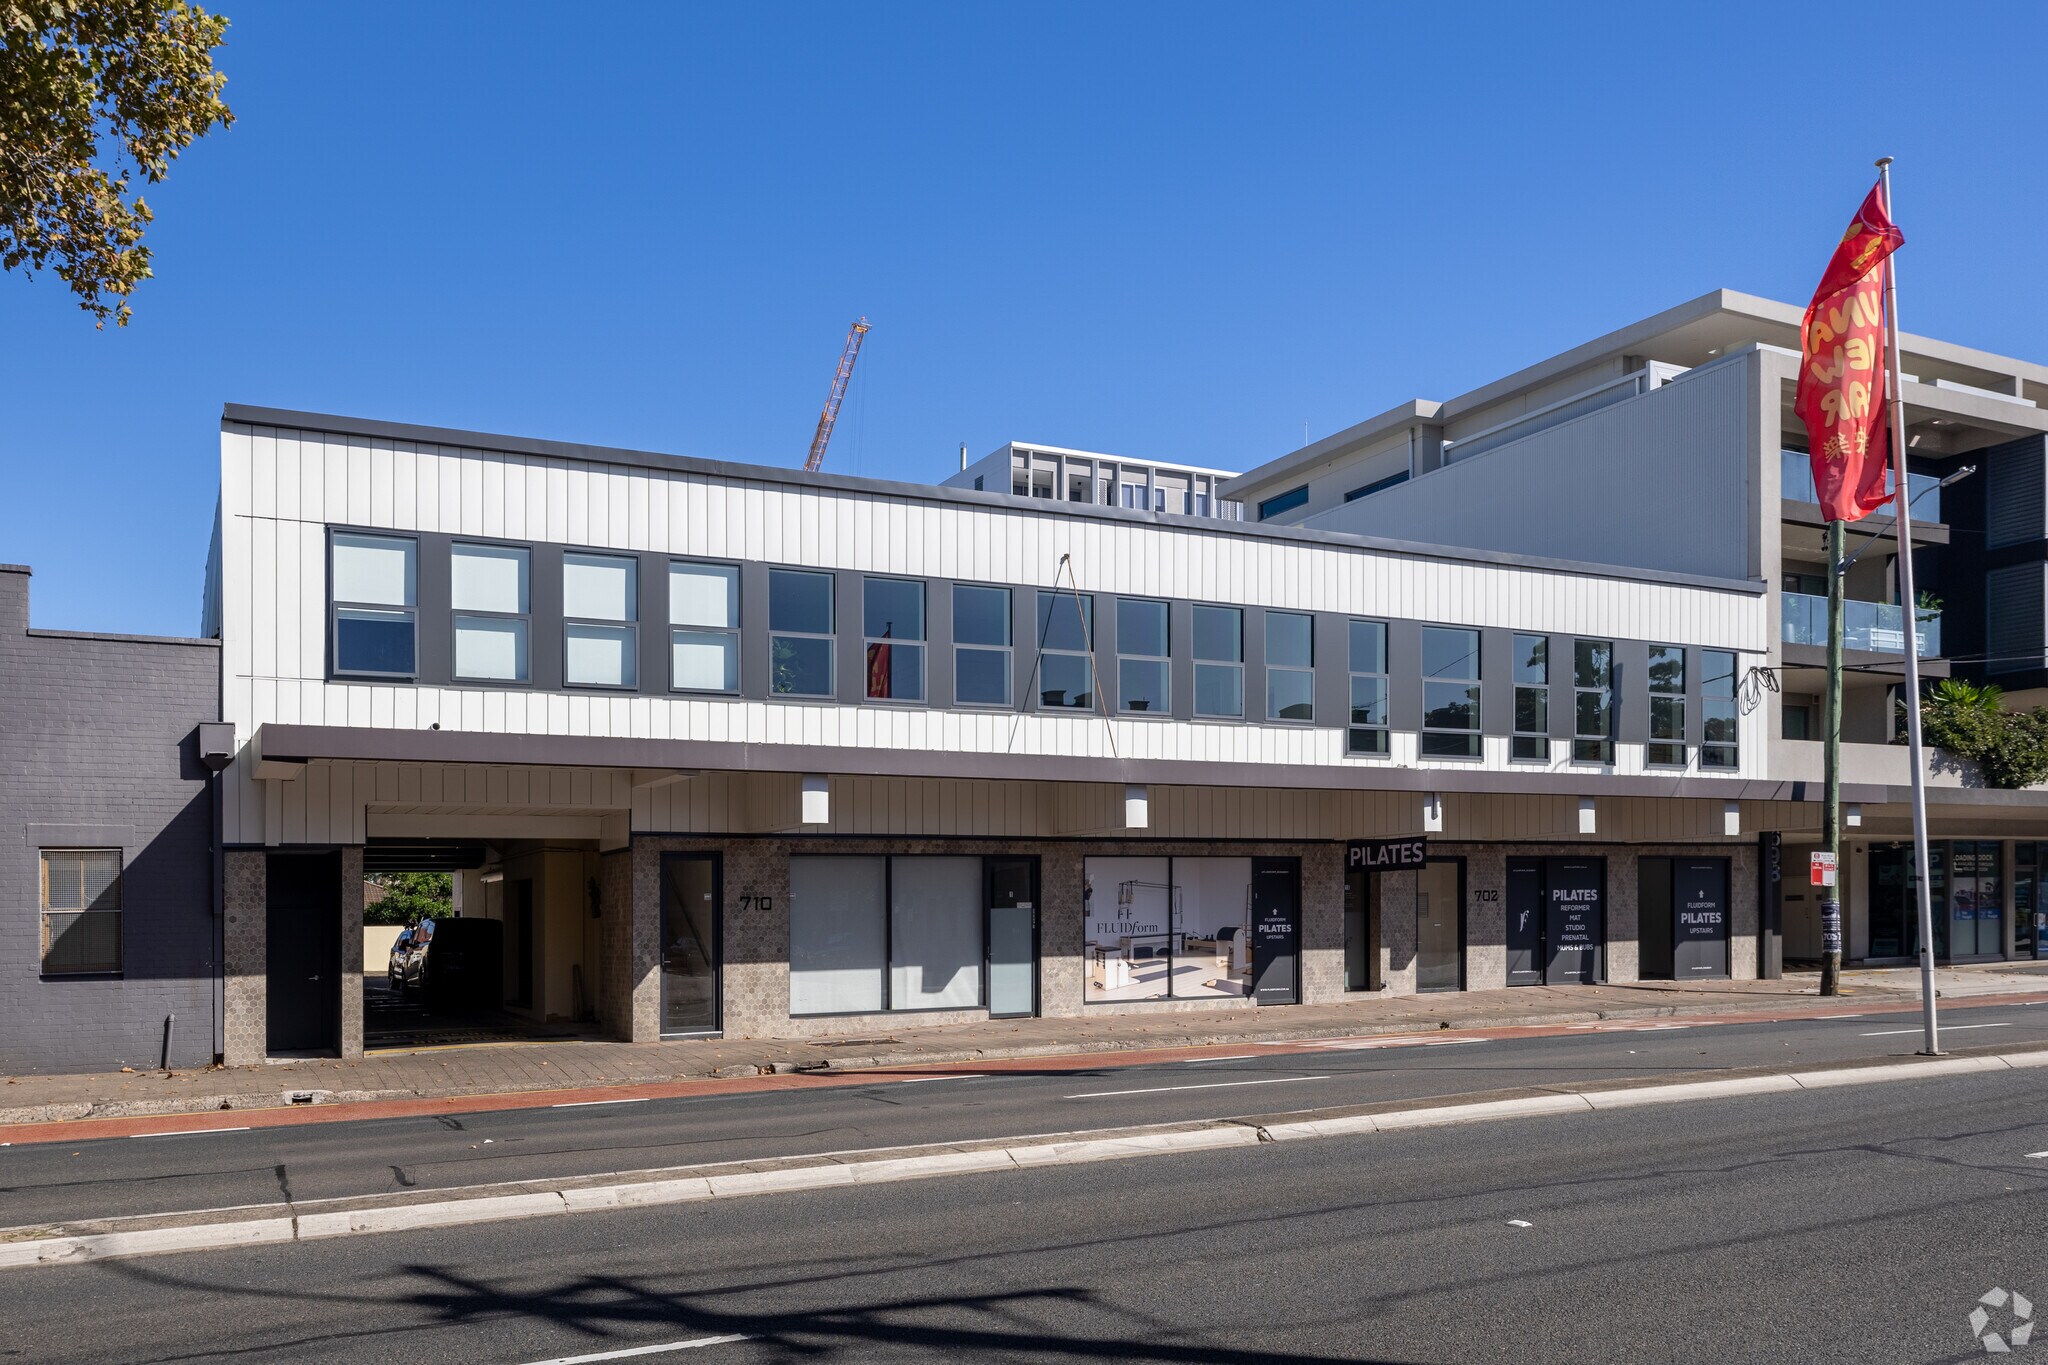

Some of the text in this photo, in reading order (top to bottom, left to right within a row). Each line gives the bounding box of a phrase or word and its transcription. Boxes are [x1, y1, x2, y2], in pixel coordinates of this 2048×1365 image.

[1350, 842, 1424, 867] PILATES
[1474, 890, 1498, 902] 702
[1552, 889, 1598, 901] PILATES
[740, 896, 771, 911] 710
[1681, 912, 1722, 924] PILATES
[1097, 921, 1158, 935] FLUIDform
[1258, 924, 1292, 933] PILATES
[1579, 943, 1594, 951] BUBS
